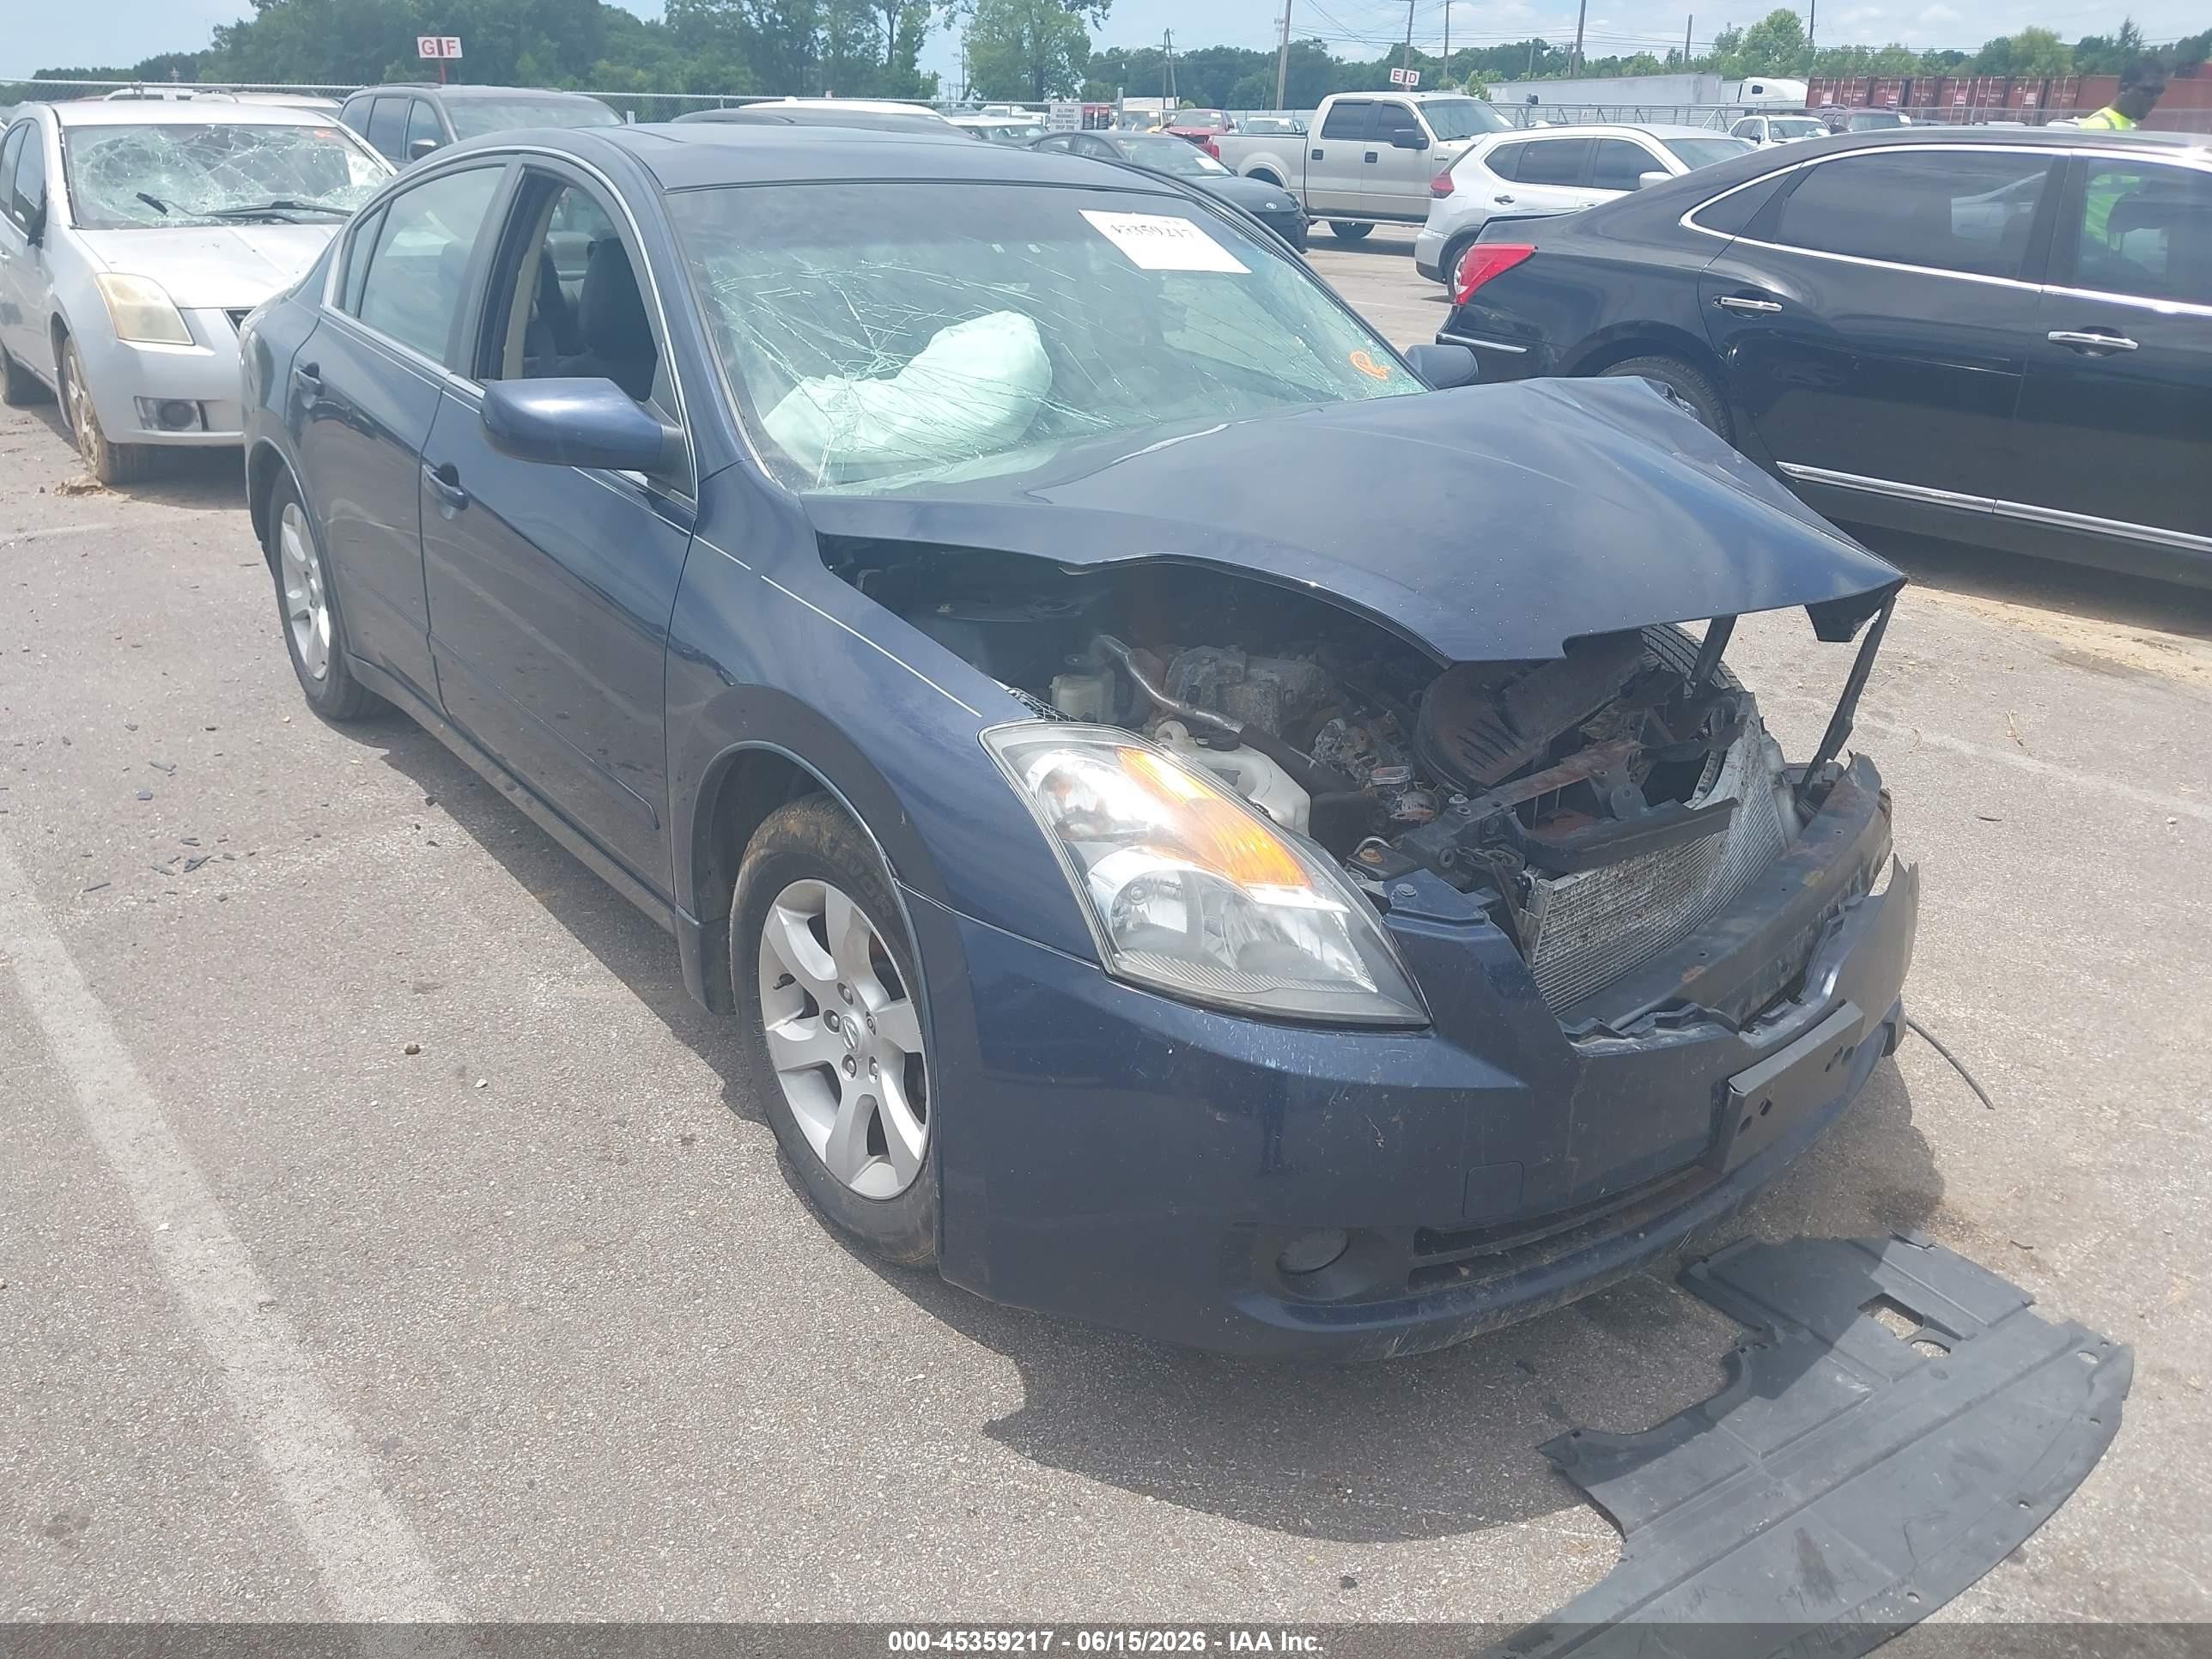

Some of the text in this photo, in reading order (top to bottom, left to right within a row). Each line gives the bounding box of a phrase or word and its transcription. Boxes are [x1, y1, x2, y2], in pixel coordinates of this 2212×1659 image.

[422, 40, 456, 56] G F
[1393, 70, 1417, 83] E D
